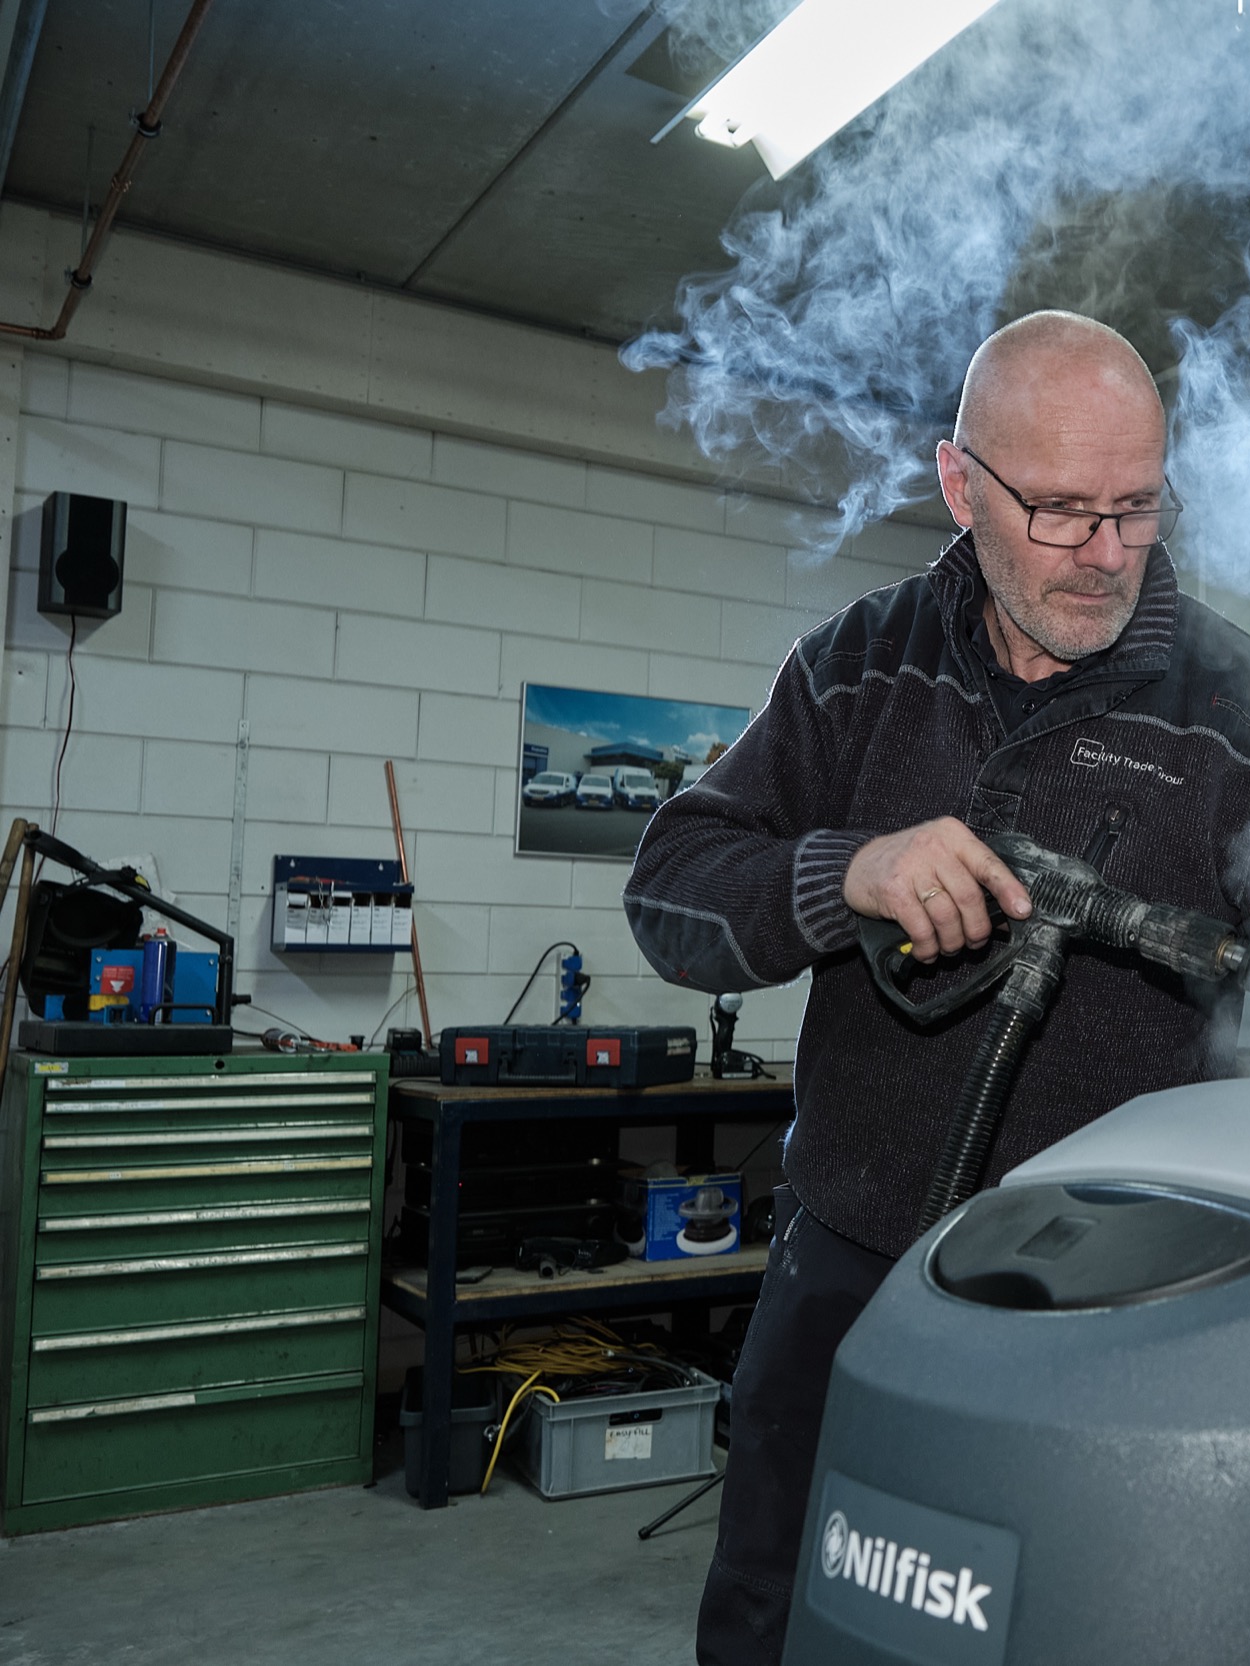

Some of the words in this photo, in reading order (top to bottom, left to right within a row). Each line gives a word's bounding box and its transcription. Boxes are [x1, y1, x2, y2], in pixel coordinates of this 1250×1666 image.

[1077, 746, 1121, 766] Facility
[1123, 756, 1155, 771] Trade
[842, 1529, 993, 1632] Nilfisk
